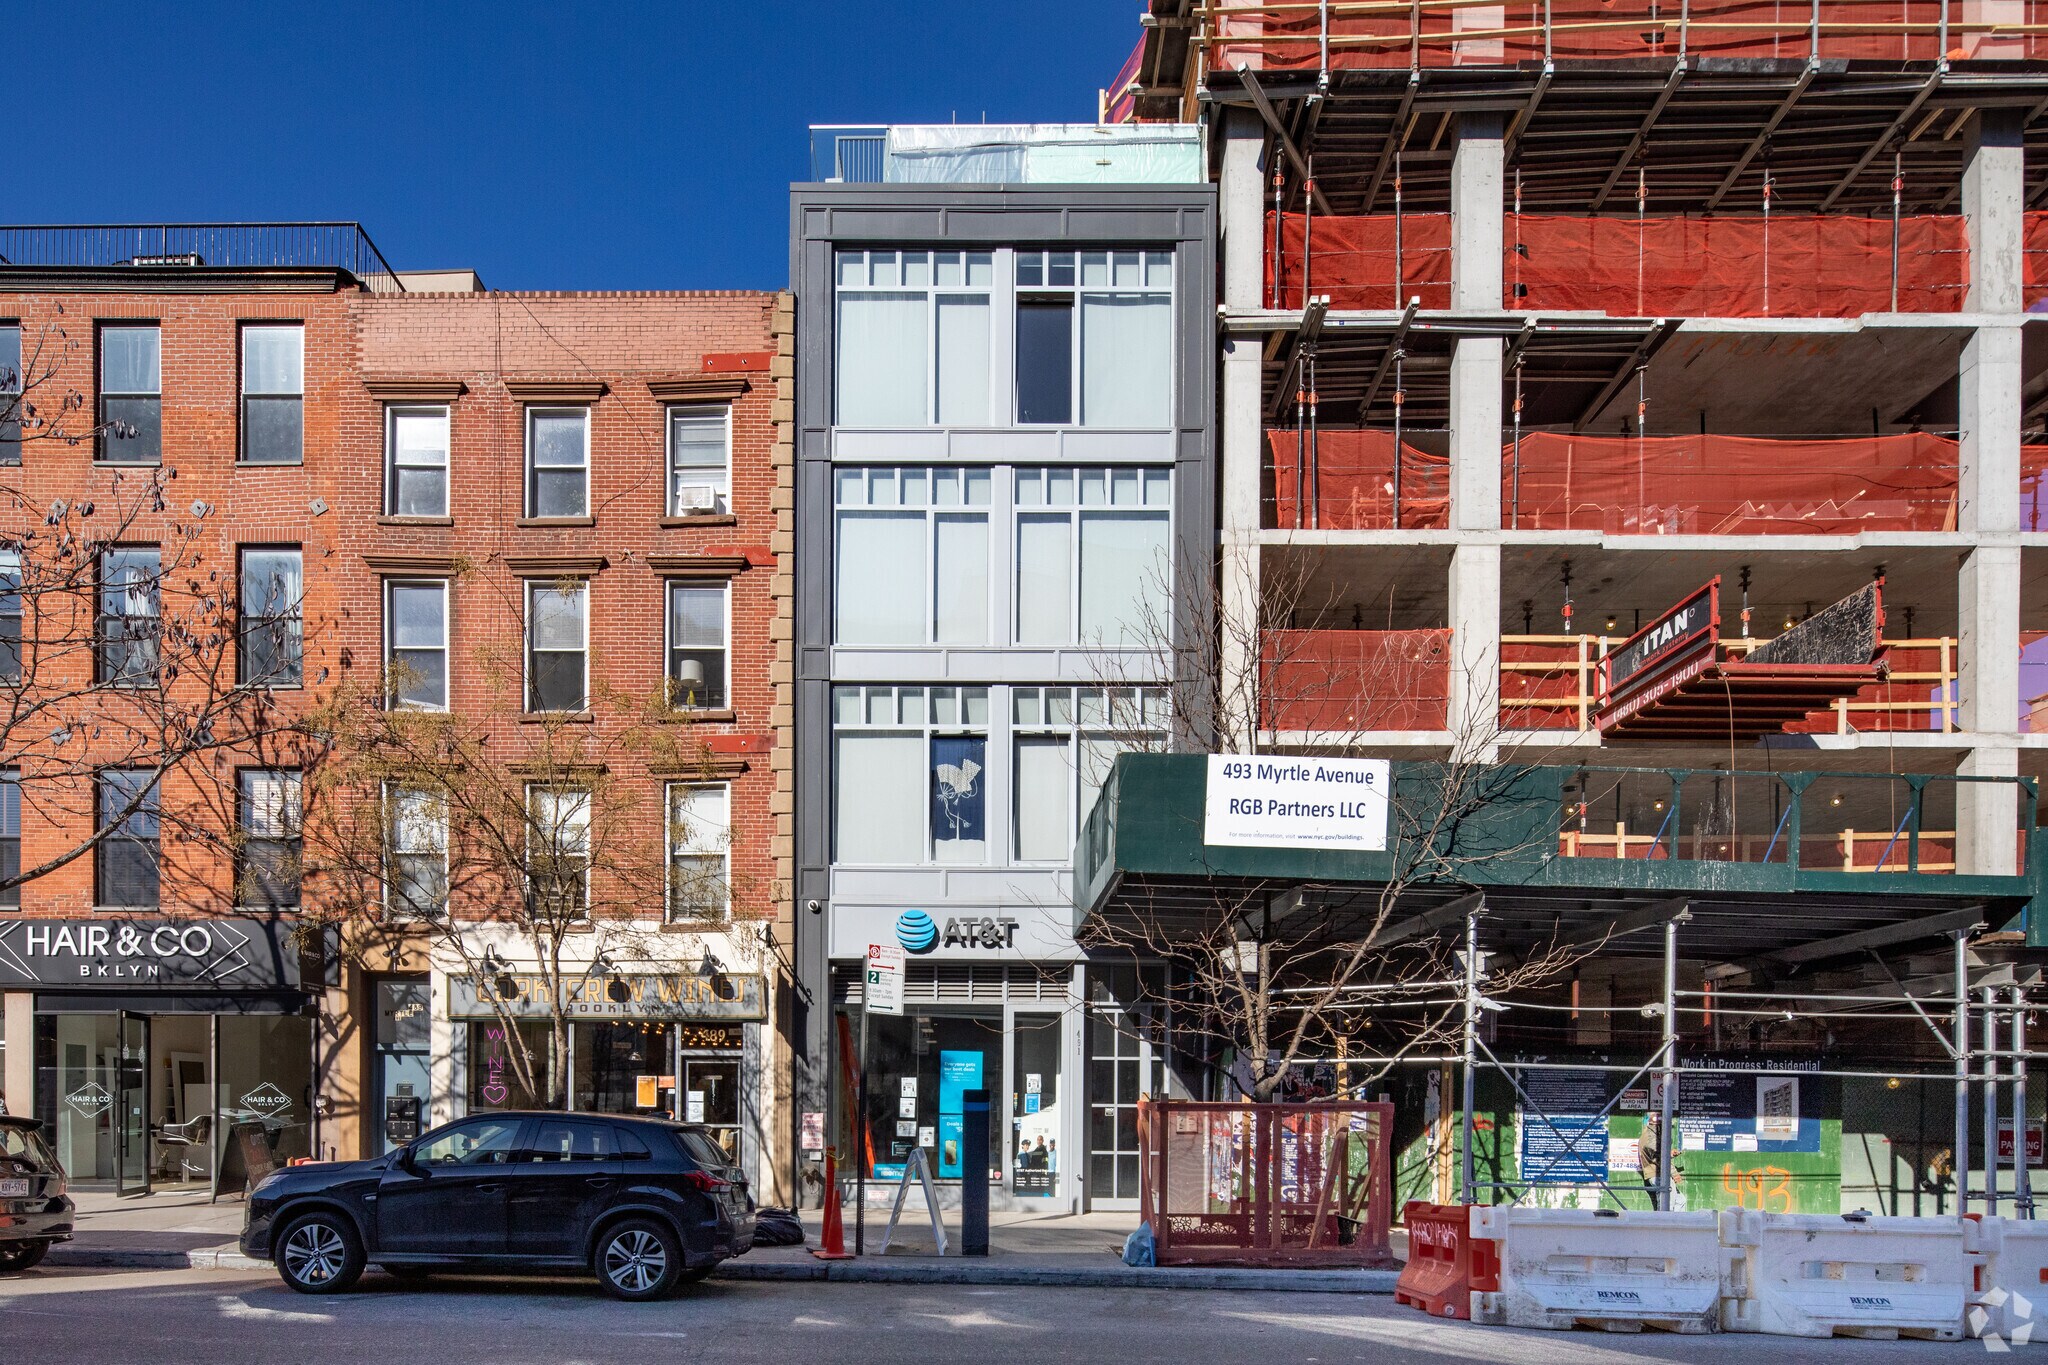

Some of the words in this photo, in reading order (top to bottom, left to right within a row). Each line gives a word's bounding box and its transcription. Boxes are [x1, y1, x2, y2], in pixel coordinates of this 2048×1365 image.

[1635, 608, 1688, 660] ITAN
[1612, 694, 1640, 722] (480)
[1642, 660, 1699, 703] 305-1900
[1223, 763, 1251, 779] 493
[1257, 764, 1310, 784] Myrtle
[1315, 766, 1374, 784] Avenue
[1229, 798, 1262, 815] RGB
[1268, 799, 1335, 818] Partners
[1340, 801, 1366, 819] LLC
[941, 917, 1015, 942] AT&T
[27, 926, 110, 956] HAIR
[117, 926, 145, 956] &
[151, 926, 212, 957] CO
[80, 965, 159, 977] BKLYN
[870, 972, 877, 983] 2
[656, 977, 747, 1003] WINES
[553, 1004, 660, 1013] ROOKLYN
[486, 1028, 505, 1084] WINE
[1681, 1058, 1705, 1069] Work
[1708, 1058, 1716, 1069] in
[1767, 1060, 1820, 1071] Residential
[2000, 1140, 2040, 1150] PANG
[1723, 1163, 1792, 1214] 493
[1597, 1290, 1640, 1299] REMCON
[1849, 1296, 1891, 1305] REMCON
